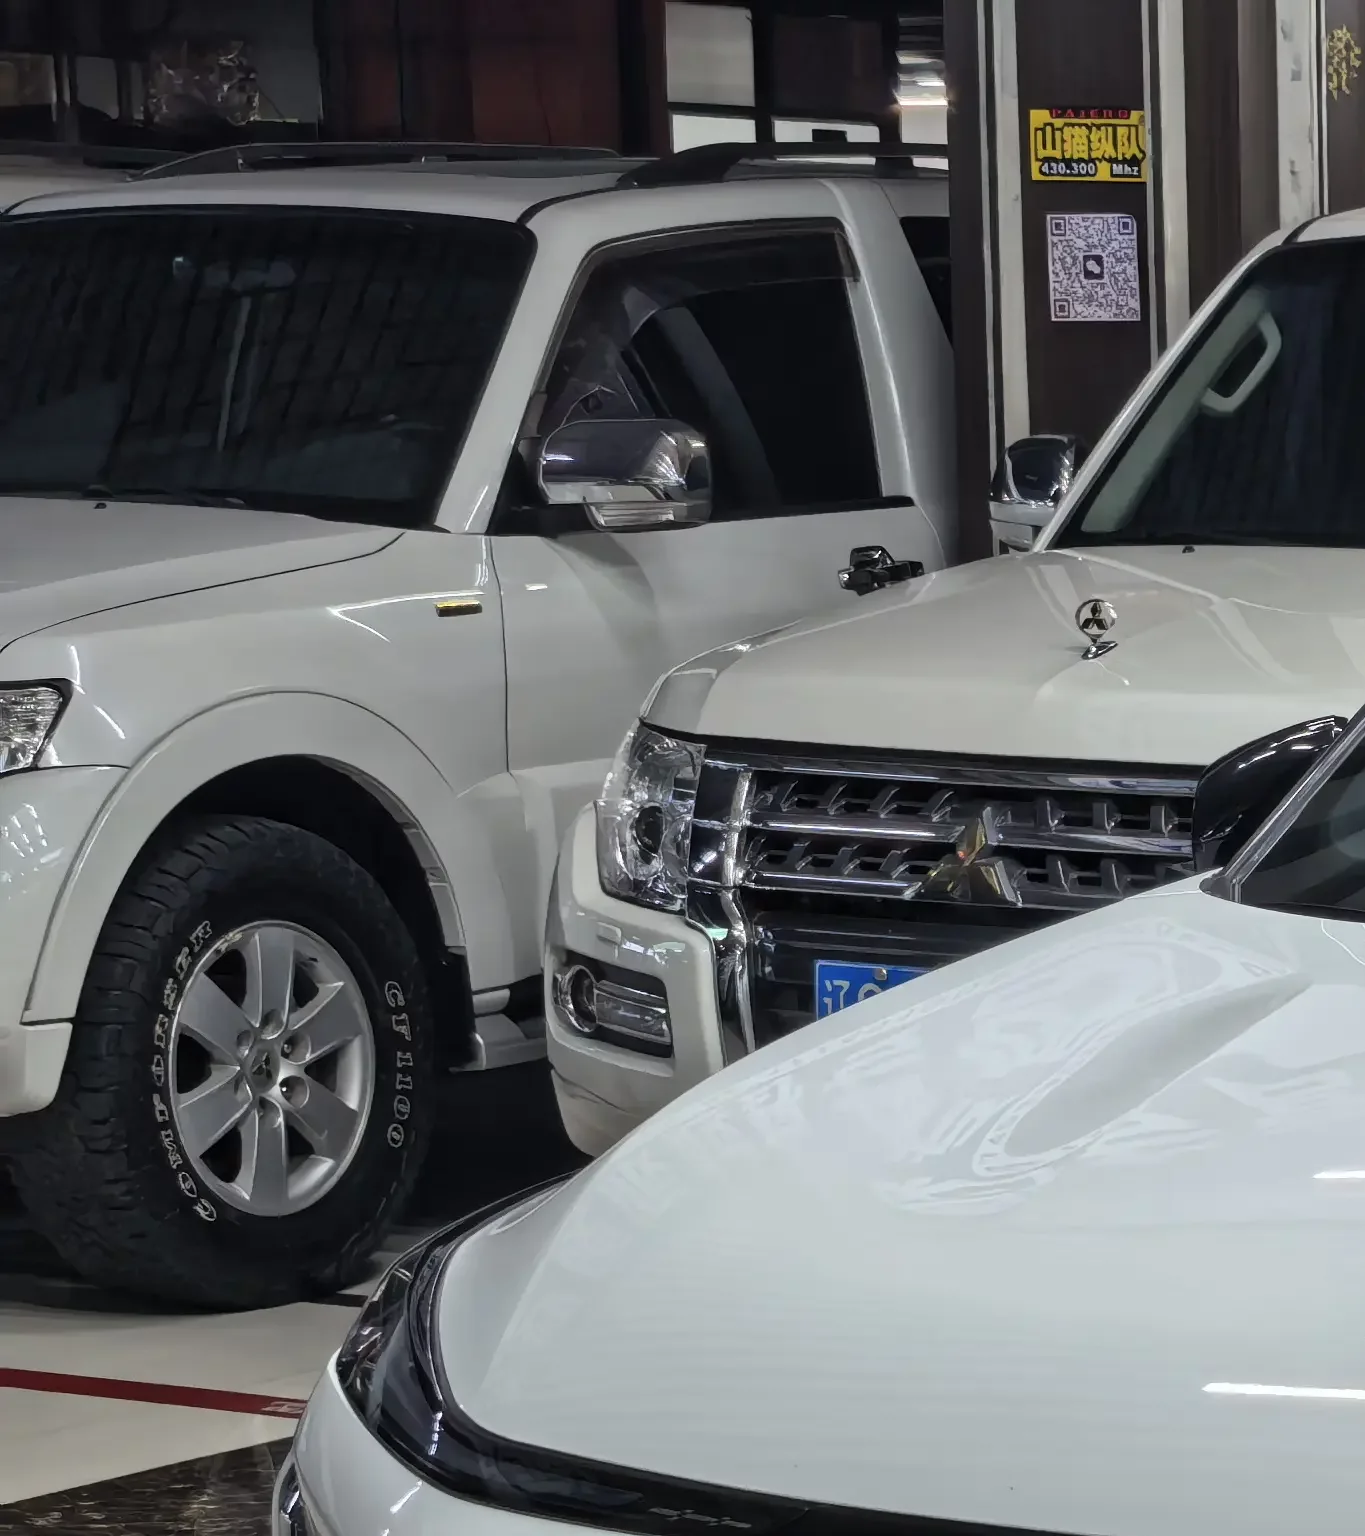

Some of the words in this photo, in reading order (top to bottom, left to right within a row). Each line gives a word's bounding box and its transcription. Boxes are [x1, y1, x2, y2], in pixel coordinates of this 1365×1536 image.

[1034, 123, 1146, 162] 山猫纵队
[1041, 162, 1096, 175] 430.300
